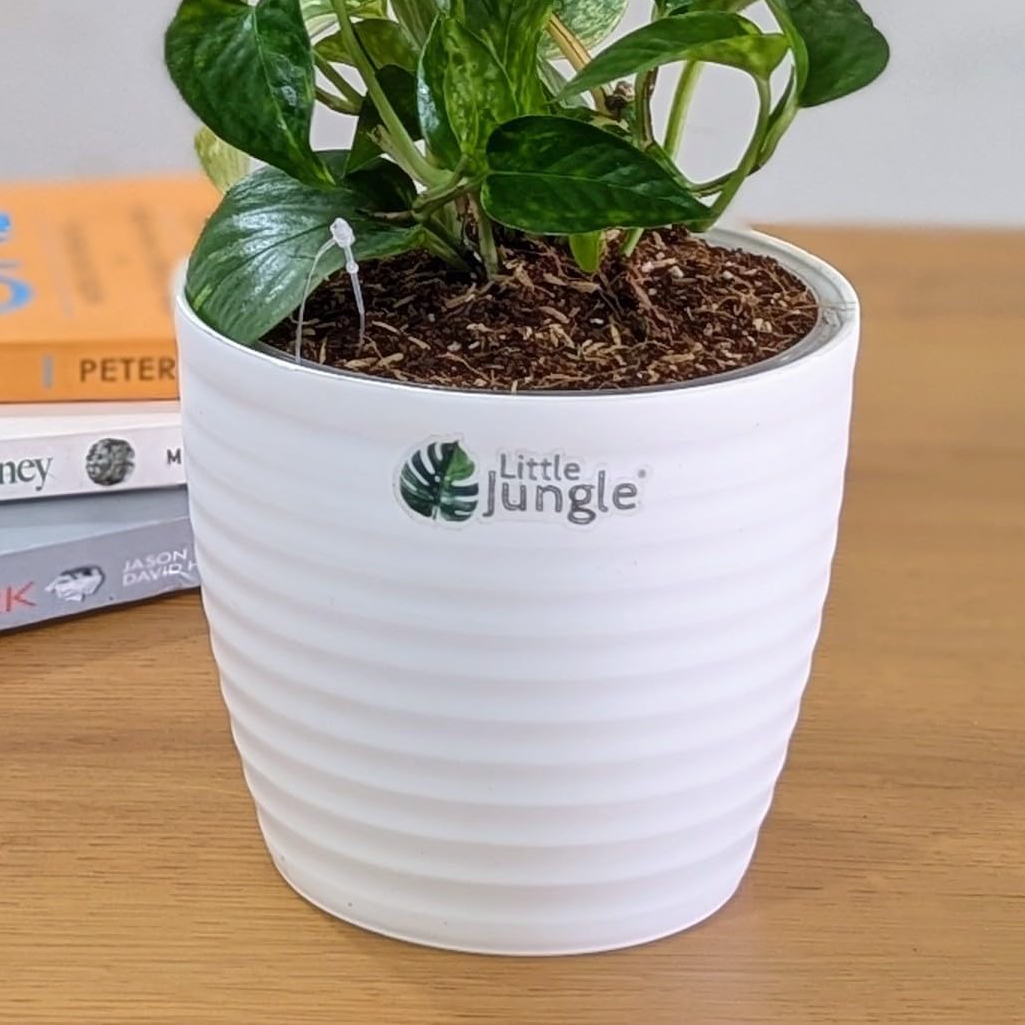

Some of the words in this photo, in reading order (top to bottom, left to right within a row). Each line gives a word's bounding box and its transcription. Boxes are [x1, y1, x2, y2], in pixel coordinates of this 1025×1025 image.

[79, 356, 176, 383] PETER
[500, 453, 581, 482] Little
[482, 470, 638, 525] Jungle
[123, 548, 188, 574] JASON
[122, 563, 182, 587] DAVID
